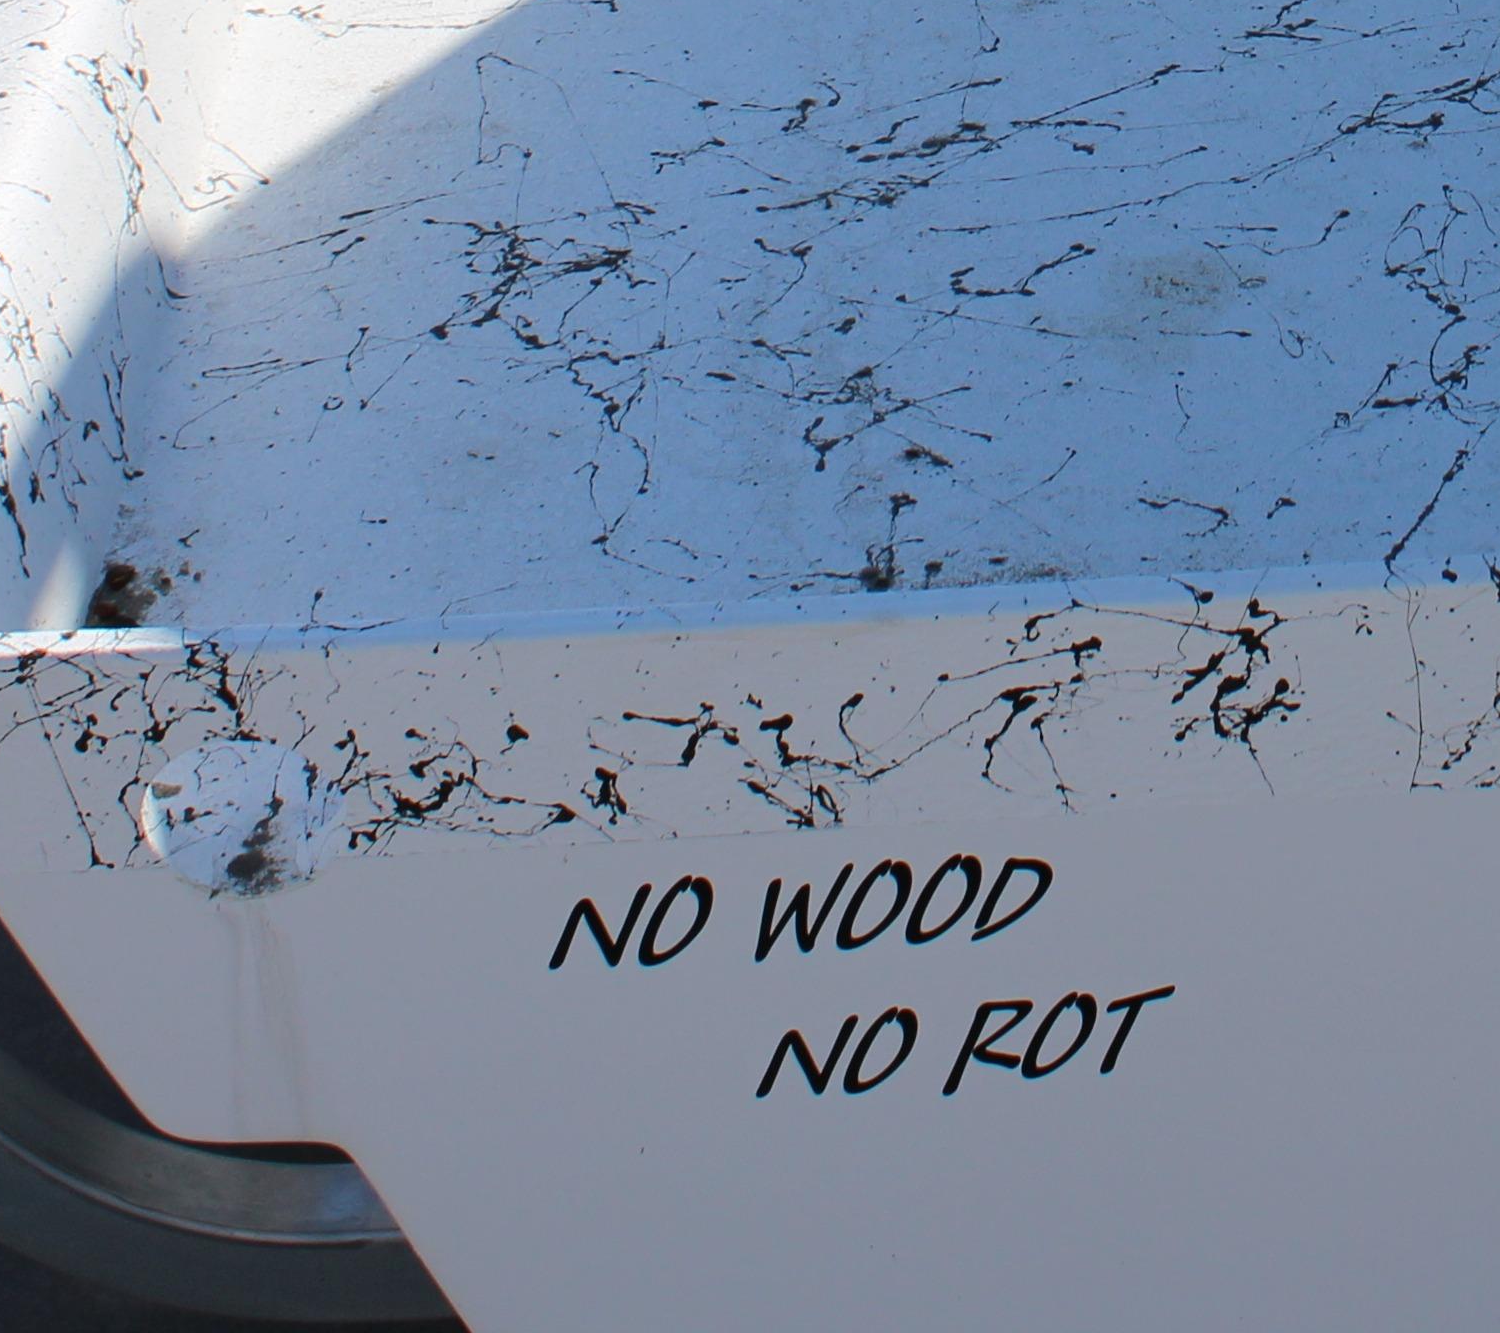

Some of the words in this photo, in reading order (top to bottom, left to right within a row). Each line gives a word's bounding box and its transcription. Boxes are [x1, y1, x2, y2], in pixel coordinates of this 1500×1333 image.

[548, 875, 714, 970] NO
[754, 853, 1053, 963] WOOD
[755, 1006, 918, 1098] NO
[942, 985, 1176, 1096] ROT
